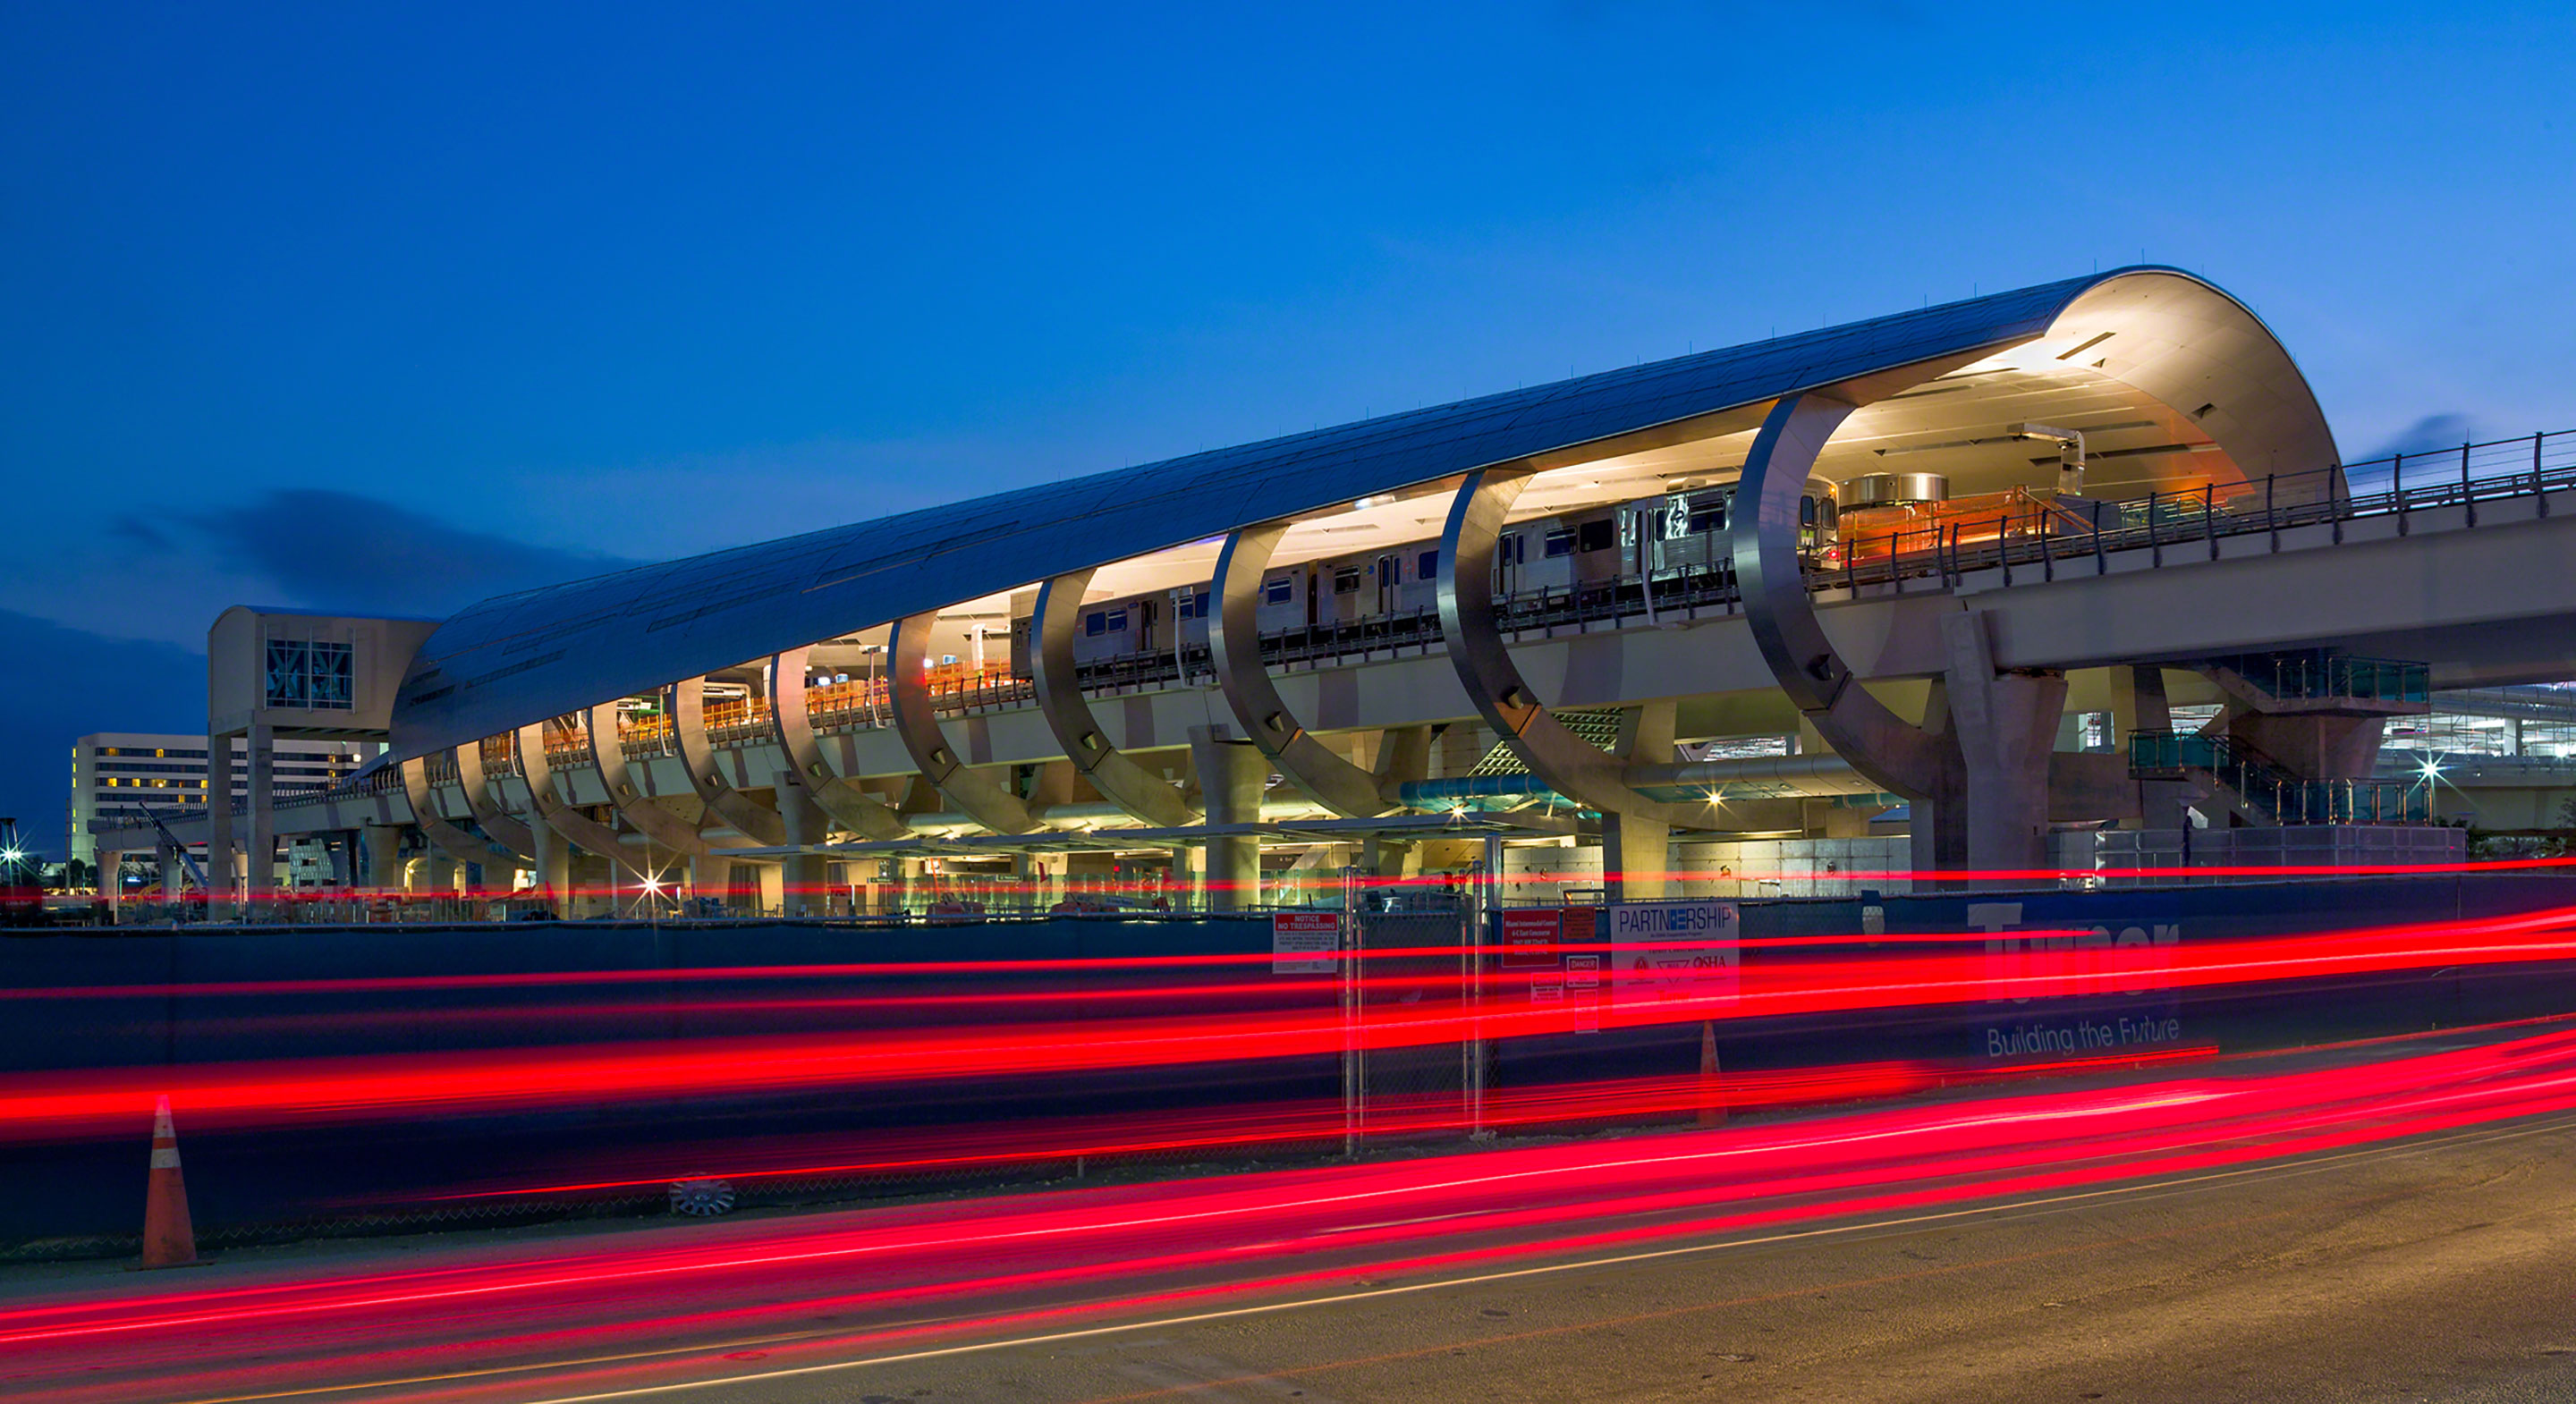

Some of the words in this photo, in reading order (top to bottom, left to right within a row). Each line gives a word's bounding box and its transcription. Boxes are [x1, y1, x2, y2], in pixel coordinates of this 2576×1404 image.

[1290, 922, 1335, 930] TRESPASSING
[1619, 907, 1732, 932] PARTNERSHIP
[1693, 955, 1726, 970] OSHA
[1968, 902, 2180, 1003] Turner
[1987, 1025, 2074, 1057] Building
[2080, 1021, 2113, 1048] the
[2119, 1015, 2179, 1045] Future
